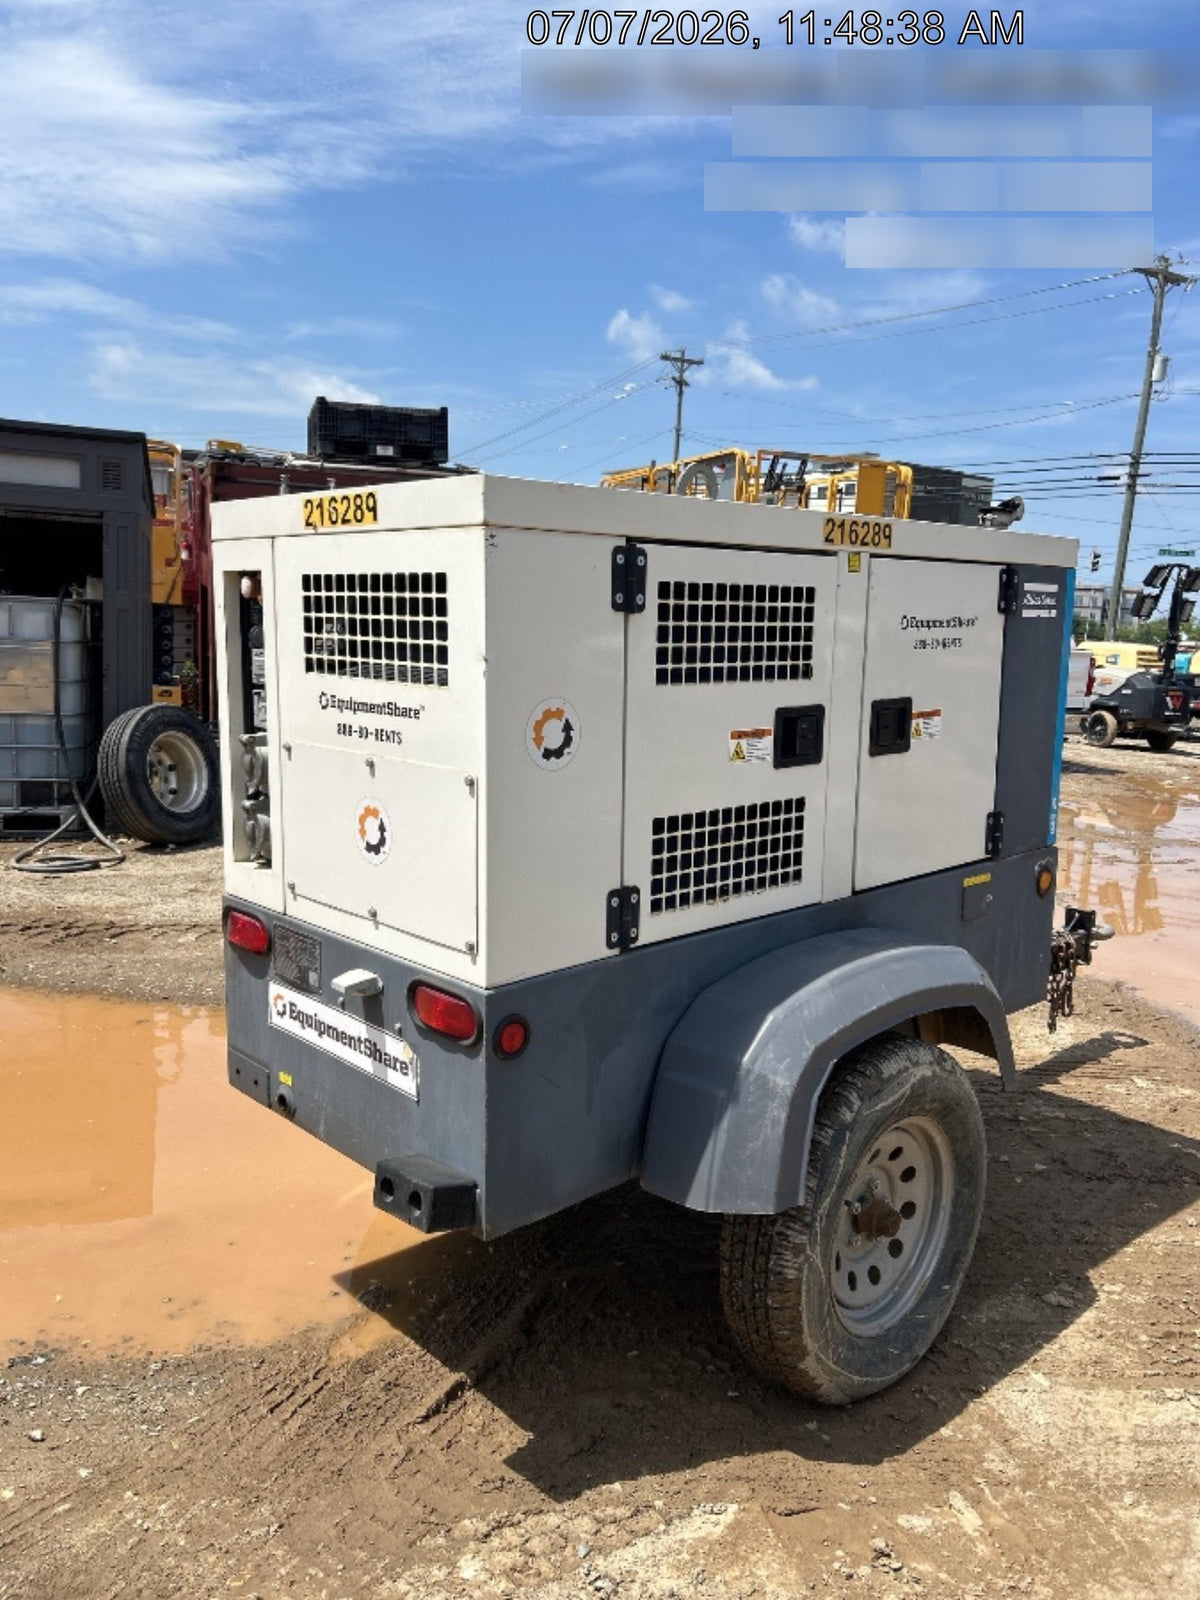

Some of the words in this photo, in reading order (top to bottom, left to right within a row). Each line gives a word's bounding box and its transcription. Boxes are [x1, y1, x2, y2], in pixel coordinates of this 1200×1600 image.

[304, 492, 378, 527] 216289
[824, 517, 892, 549] 216289
[330, 694, 421, 720] EquipmentShare
[288, 1000, 410, 1077] EquipmentShare
